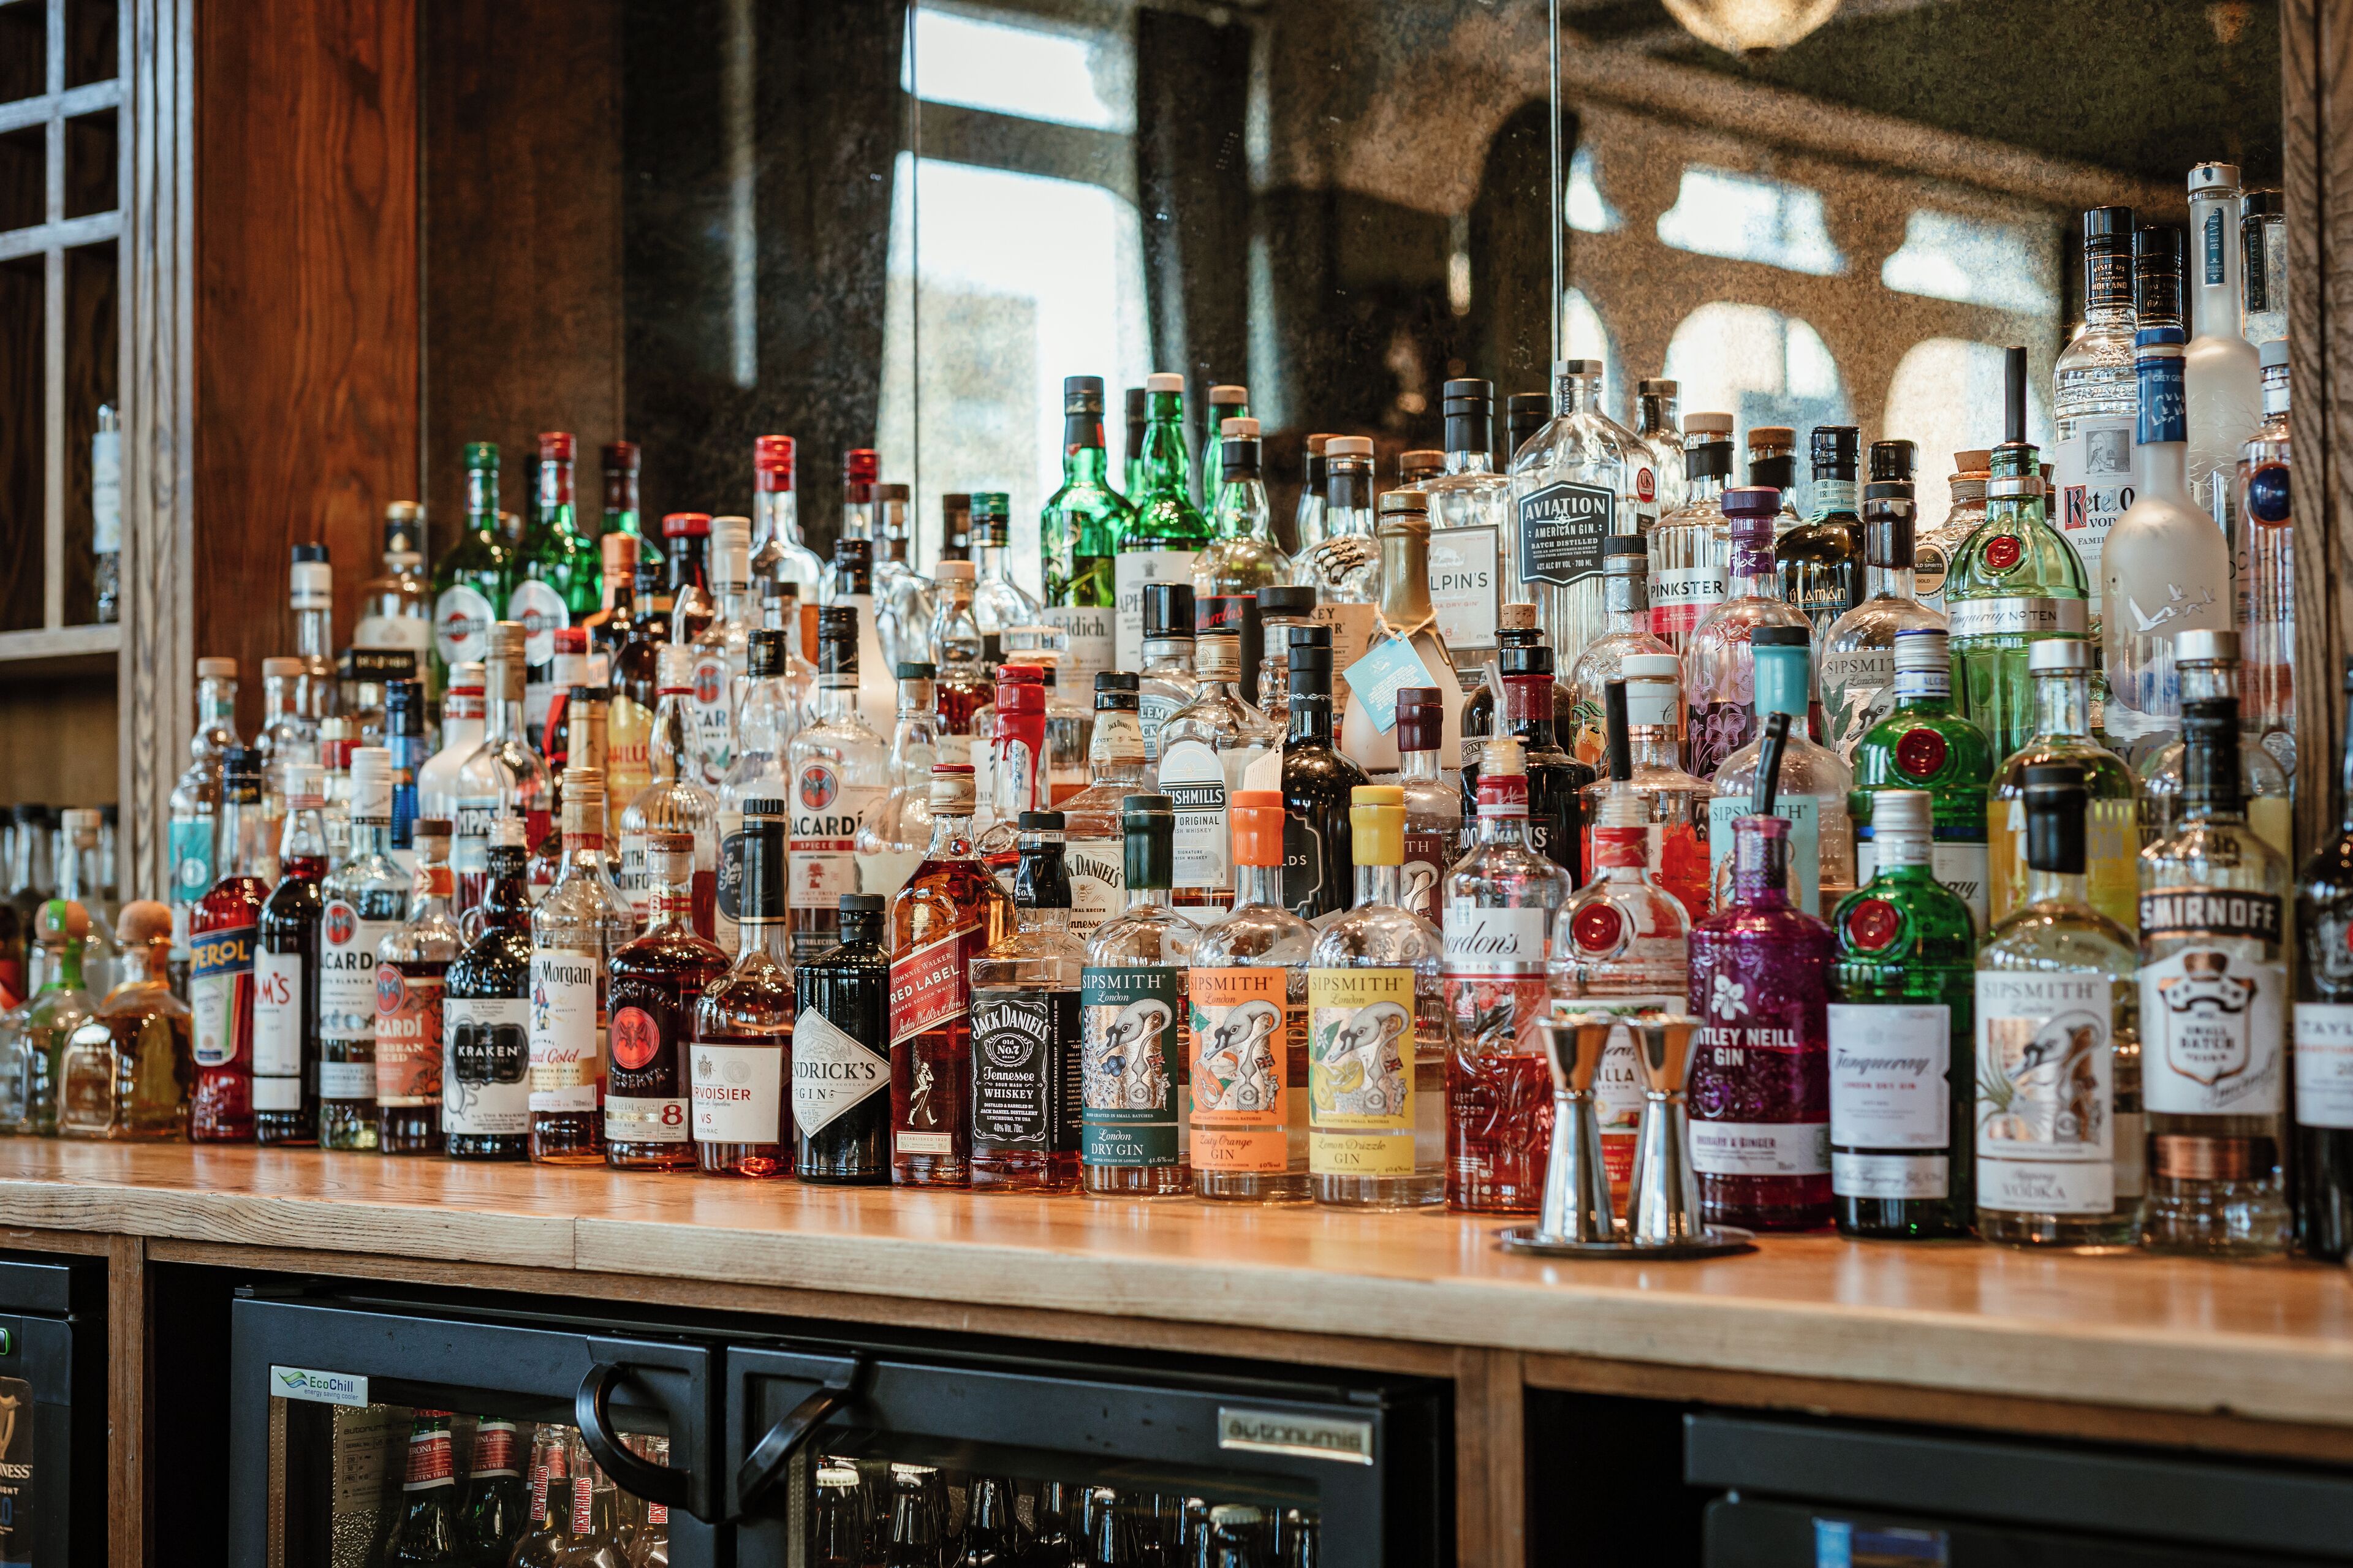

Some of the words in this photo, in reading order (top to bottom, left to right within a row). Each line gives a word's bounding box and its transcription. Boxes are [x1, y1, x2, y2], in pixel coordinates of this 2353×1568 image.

[2093, 263, 2112, 273] VISIT
[2091, 282, 2128, 290] HOLLAND
[1640, 474, 1651, 487] UK
[1525, 497, 1605, 522] AVIATION
[2065, 487, 2117, 526] Ketel
[1535, 525, 1576, 539] AMERICAN
[1578, 523, 1594, 535] GIN
[1531, 541, 1555, 550] BATCH
[1556, 537, 1598, 547] DISTILLED
[1430, 572, 1488, 591] LPIN'S
[1651, 579, 1724, 599] PINKSTER
[1949, 608, 2006, 627] Tanqueray
[2029, 610, 2057, 621] TEN
[1445, 627, 1452, 637] 8
[1827, 657, 1896, 676] SIPSMIT
[1847, 673, 1885, 686] London
[1180, 816, 1220, 826] ORIGINAL
[1075, 854, 1123, 888] DANIEL'S
[2140, 896, 2276, 931] SMIRNOFF
[542, 961, 593, 987] Morgan
[892, 968, 921, 988] JOHNNIE
[922, 953, 951, 970] WALKER
[890, 985, 913, 1006] RED
[915, 964, 960, 991] LABEL
[1083, 974, 1162, 989] SIPSMITH
[1191, 975, 1268, 991] SIPSMITH
[1313, 977, 1399, 991] SIPSMITH
[1097, 990, 1130, 1003] London
[1982, 981, 2096, 1000] SIPSMITH
[890, 1003, 912, 1017] BLENDED
[913, 992, 934, 1005] SCOTCH
[937, 981, 960, 994] WHISKY
[1204, 992, 1237, 1005] London
[1330, 993, 1365, 1006] London
[895, 1017, 915, 1040] John
[915, 1006, 942, 1027] Walker
[971, 1010, 999, 1040] JACK
[1001, 1005, 1051, 1042] DANIEL'S
[1746, 1028, 1798, 1048] NEILL
[2179, 1036, 2235, 1050] BATCH
[458, 1045, 518, 1058] KRAKEN
[547, 1048, 580, 1064] Gold
[997, 1045, 1020, 1055] No.7
[1714, 1048, 1745, 1067] GIN
[1835, 1048, 1931, 1077] Tanqueray
[983, 1066, 1035, 1081] Tennessee
[693, 1086, 751, 1100] RVOISIER
[799, 1088, 827, 1099] GIN
[984, 1088, 1034, 1099] WHISKEY
[662, 1104, 683, 1126] 8
[700, 1113, 711, 1124] VS
[993, 1123, 1004, 1132] 40%
[1098, 1128, 1132, 1141] London
[1091, 1143, 1114, 1154] DRY
[1116, 1144, 1144, 1156] GIN
[1200, 1135, 1218, 1149] Zesty
[1218, 1135, 1252, 1149] Orange
[1345, 1138, 1386, 1150] Drizzle
[1211, 1149, 1235, 1160] GIN
[1335, 1153, 1360, 1164] GIN
[309, 1376, 354, 1393] EcoChill
[304, 1388, 322, 1398] energy
[323, 1390, 341, 1400] saving
[531, 1465, 550, 1521] DESPERADOS
[573, 1477, 593, 1534] DESPERADOS
